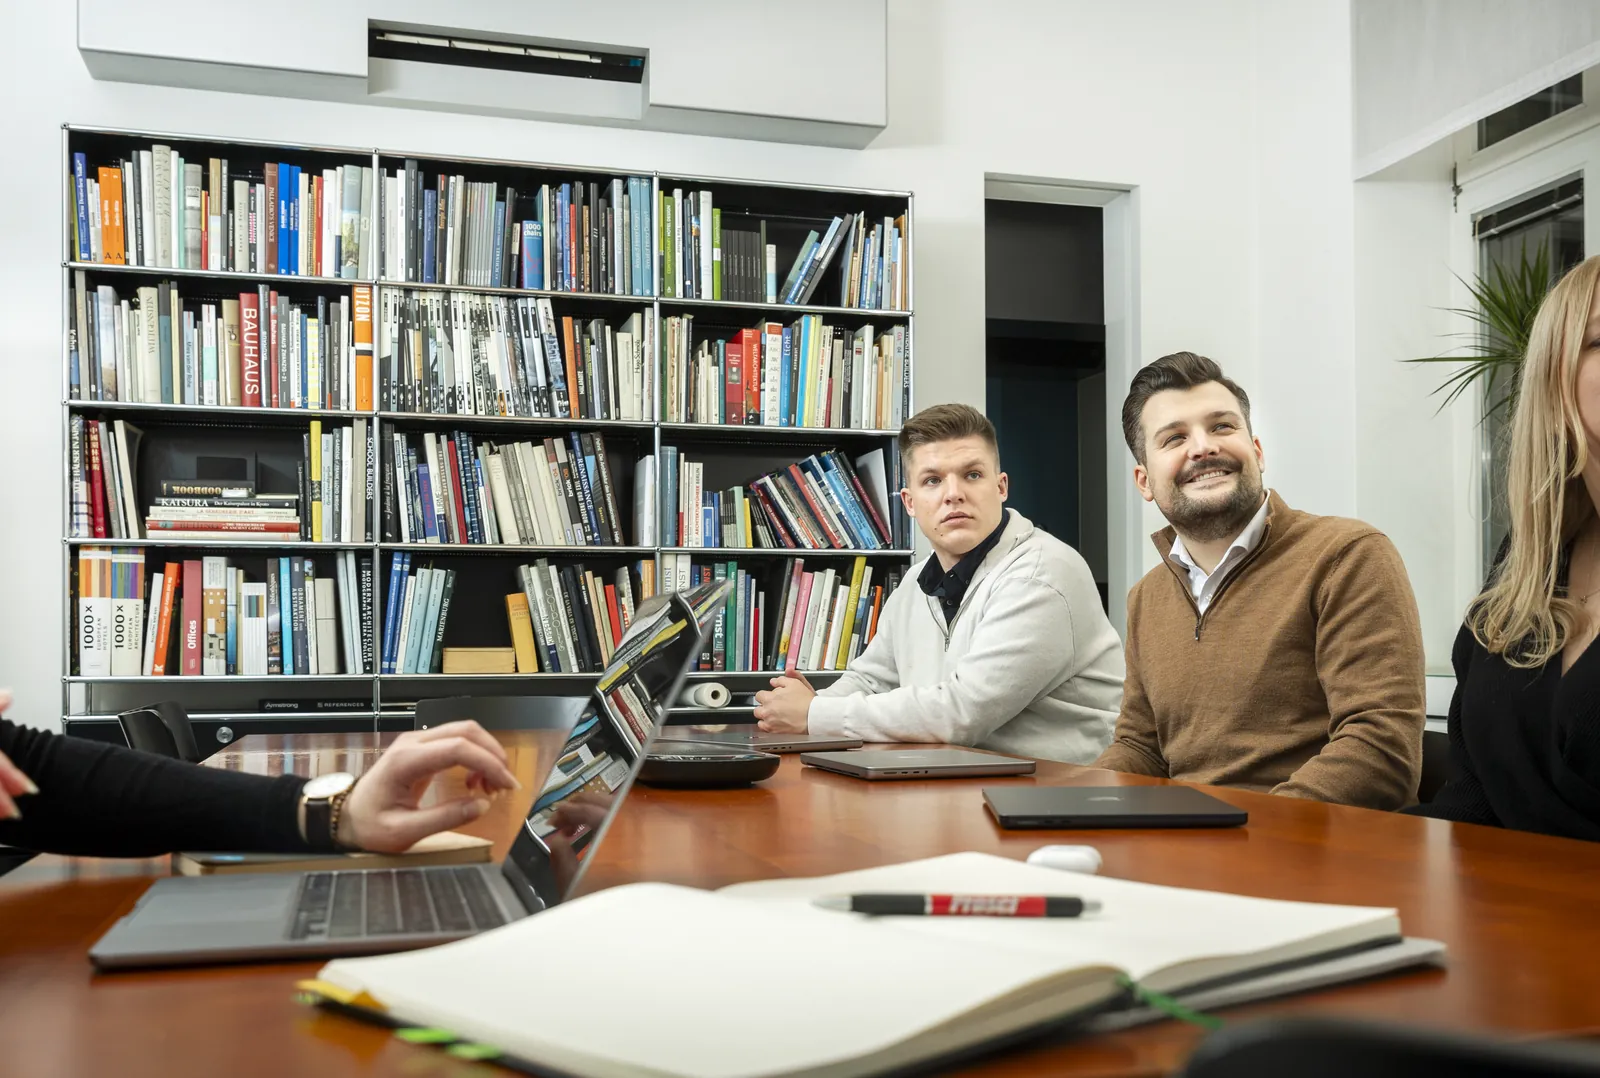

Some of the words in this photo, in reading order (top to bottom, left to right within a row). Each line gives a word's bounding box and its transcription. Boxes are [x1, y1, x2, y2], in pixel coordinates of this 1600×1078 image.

[354, 286, 369, 322] UTZON
[146, 295, 156, 354] WITTGENSTEIN
[242, 308, 258, 395] BAUHAUS
[576, 458, 592, 510] RENAISSANCE
[663, 567, 672, 591] ernst
[848, 582, 860, 611] Sander
[84, 614, 94, 648] 1000
[115, 614, 124, 648] 1000
[188, 619, 197, 648] Offices
[437, 597, 450, 641] MARIENBURG
